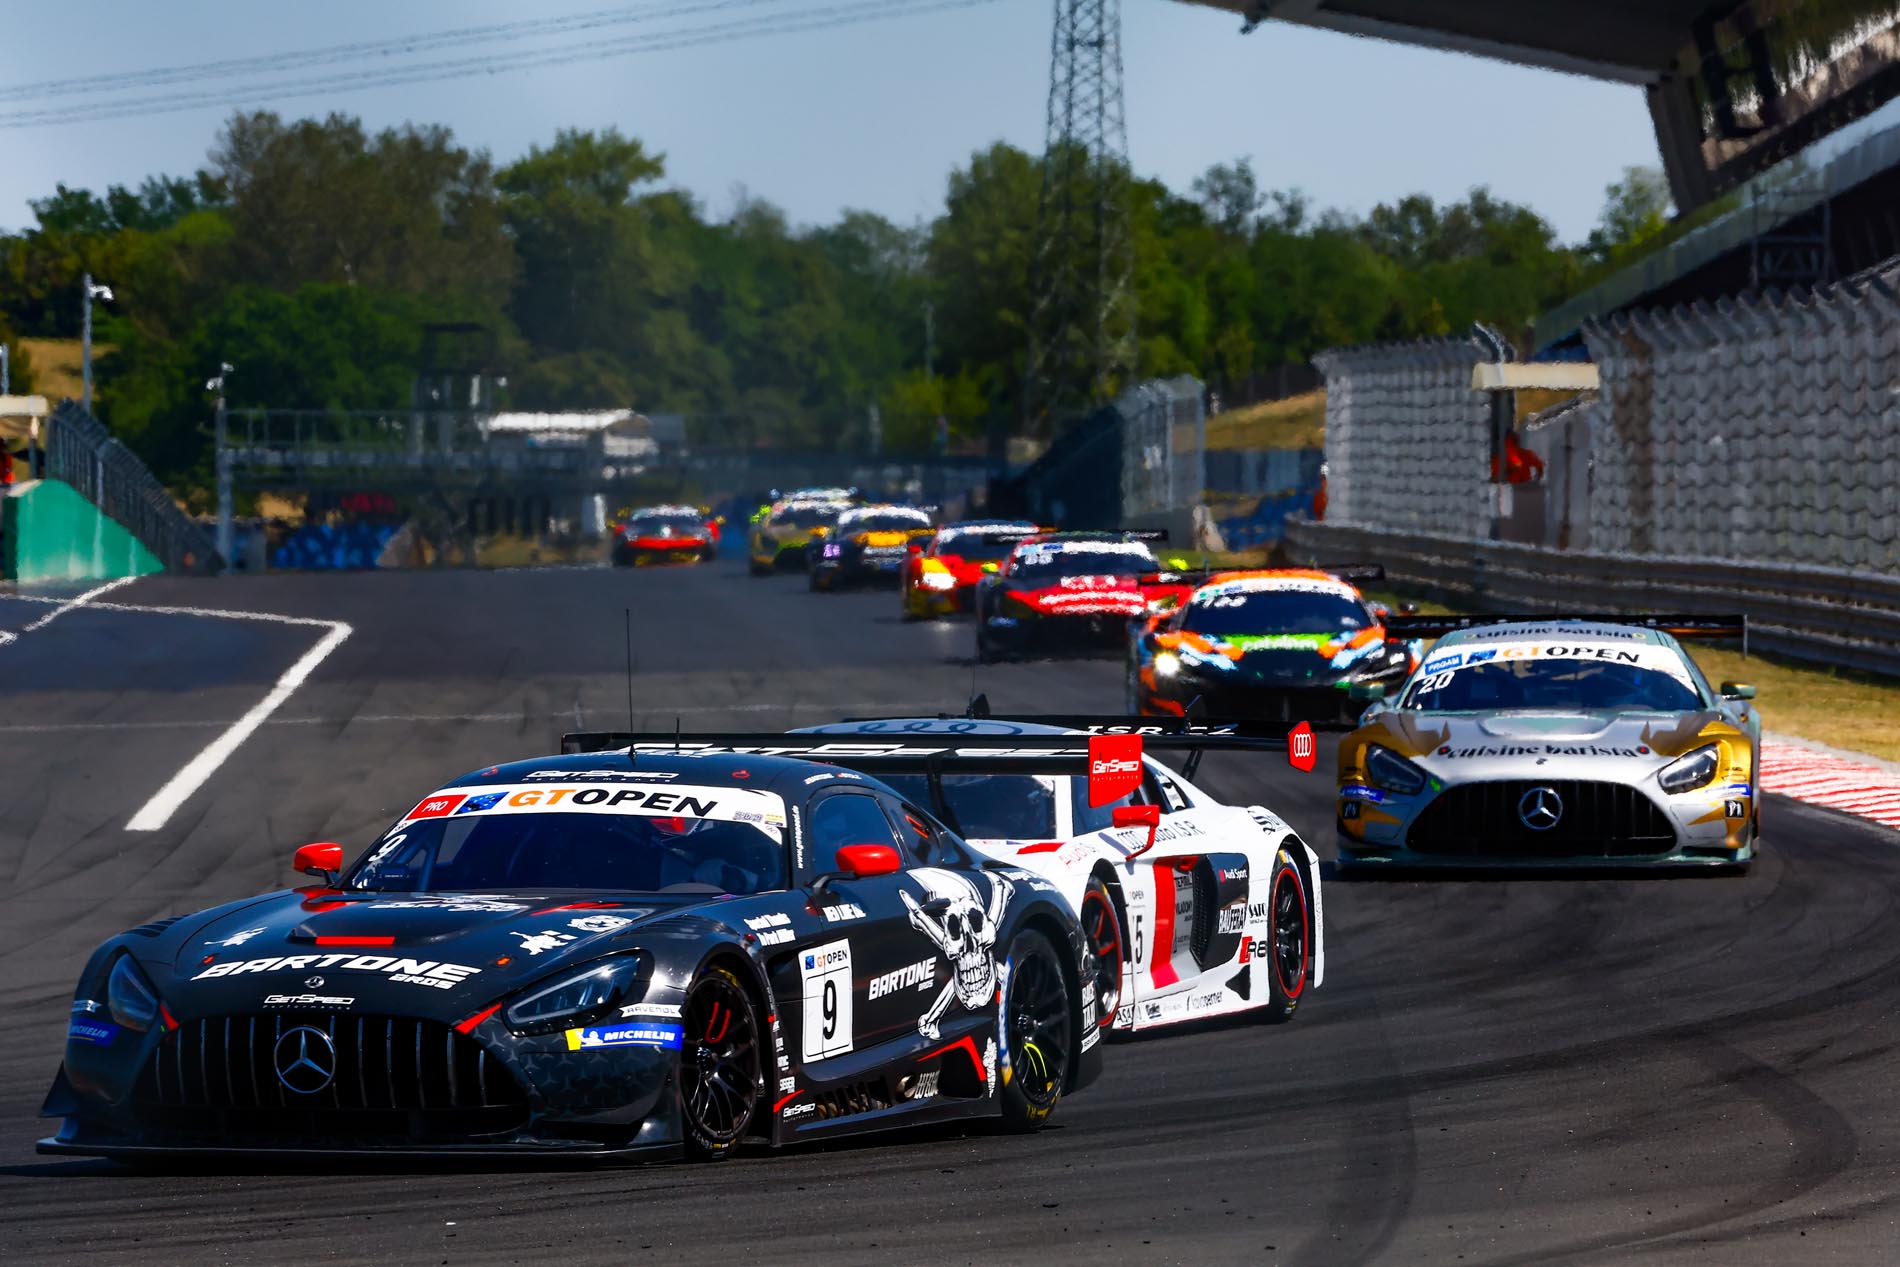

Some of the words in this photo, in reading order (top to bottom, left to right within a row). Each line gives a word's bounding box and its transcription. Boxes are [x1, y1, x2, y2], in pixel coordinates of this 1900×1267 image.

[1417, 671, 1456, 695] 20
[1448, 745, 1539, 758] cuisine
[1545, 745, 1638, 758] barista
[422, 800, 449, 813] PRO
[368, 834, 407, 862] 9
[190, 954, 483, 981] BARTONE
[389, 973, 456, 990] BROS
[868, 957, 937, 1001] BARTONE
[627, 1006, 676, 1014] RAVENOL
[823, 979, 837, 1040] 9
[604, 1030, 676, 1041] MICHELIN
